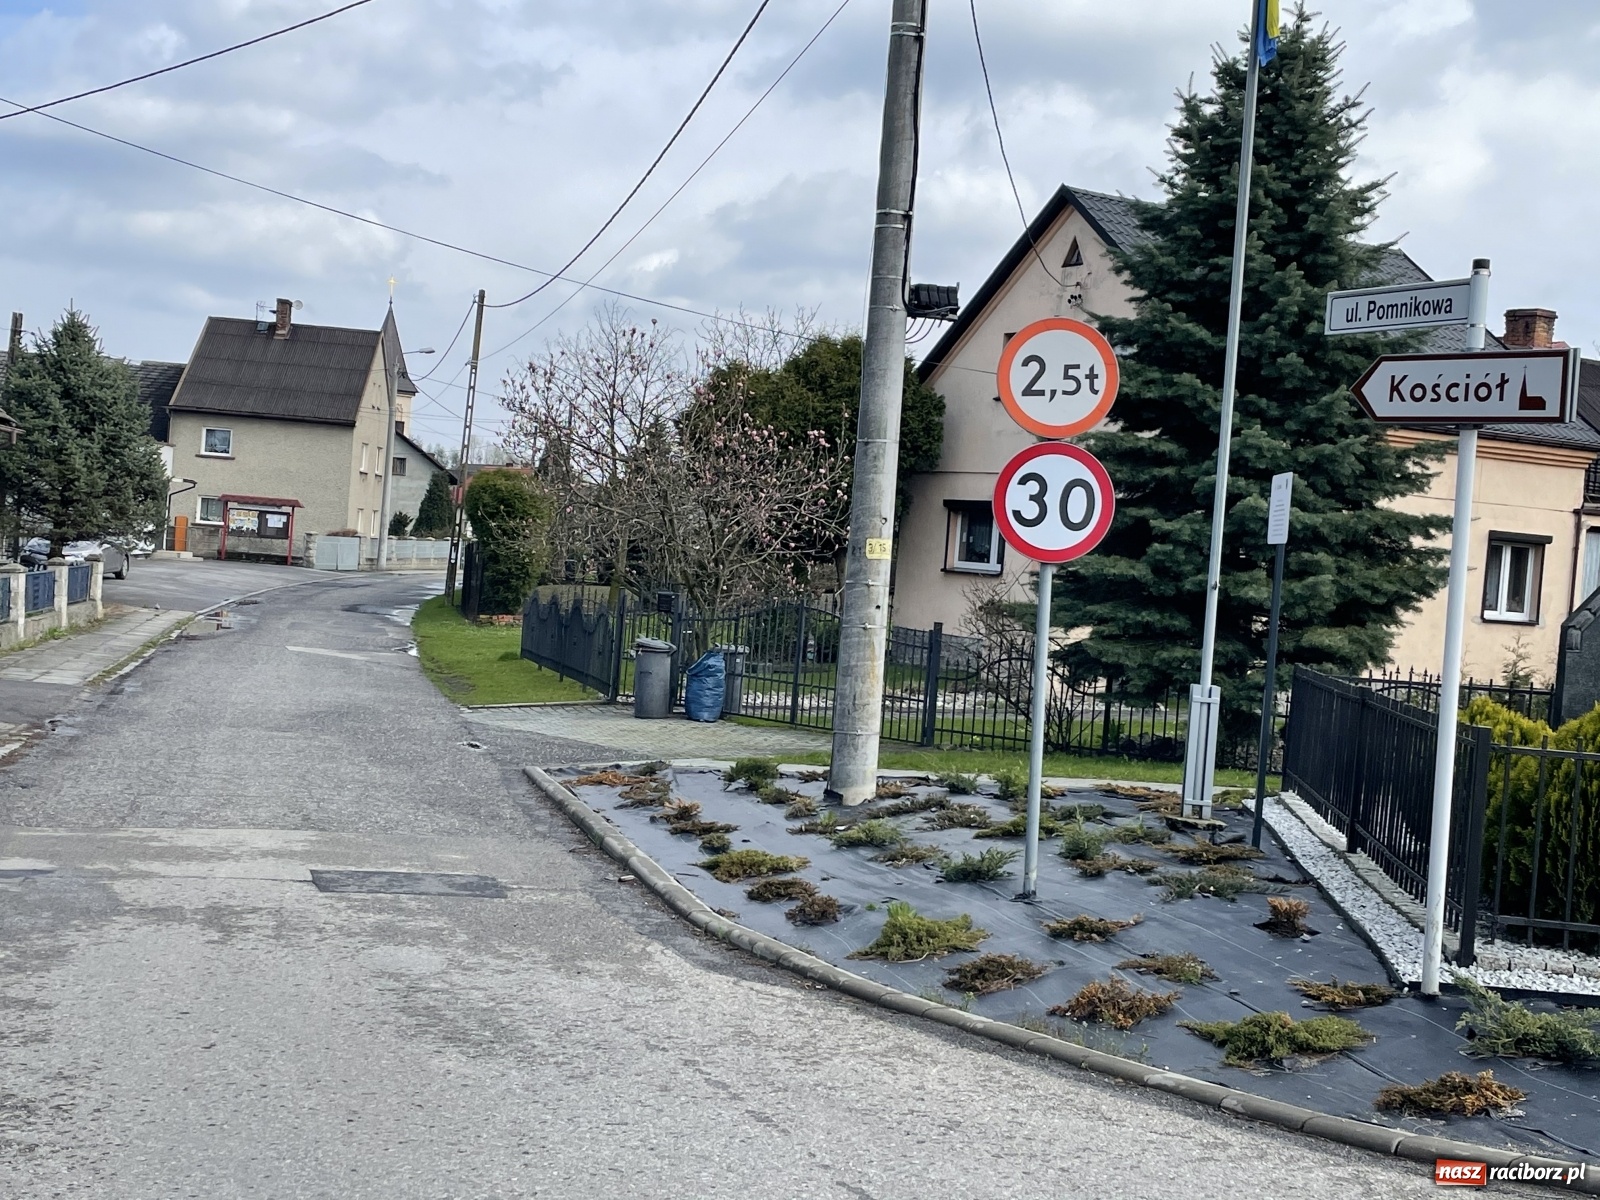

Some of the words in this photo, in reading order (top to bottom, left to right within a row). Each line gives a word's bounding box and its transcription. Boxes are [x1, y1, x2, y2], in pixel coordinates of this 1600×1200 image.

[1345, 302, 1362, 323] ul.
[1367, 296, 1453, 322] Pomnikowa
[1021, 354, 1100, 403] 2,5t
[1389, 373, 1510, 403] Kościół
[1011, 472, 1096, 532] 30
